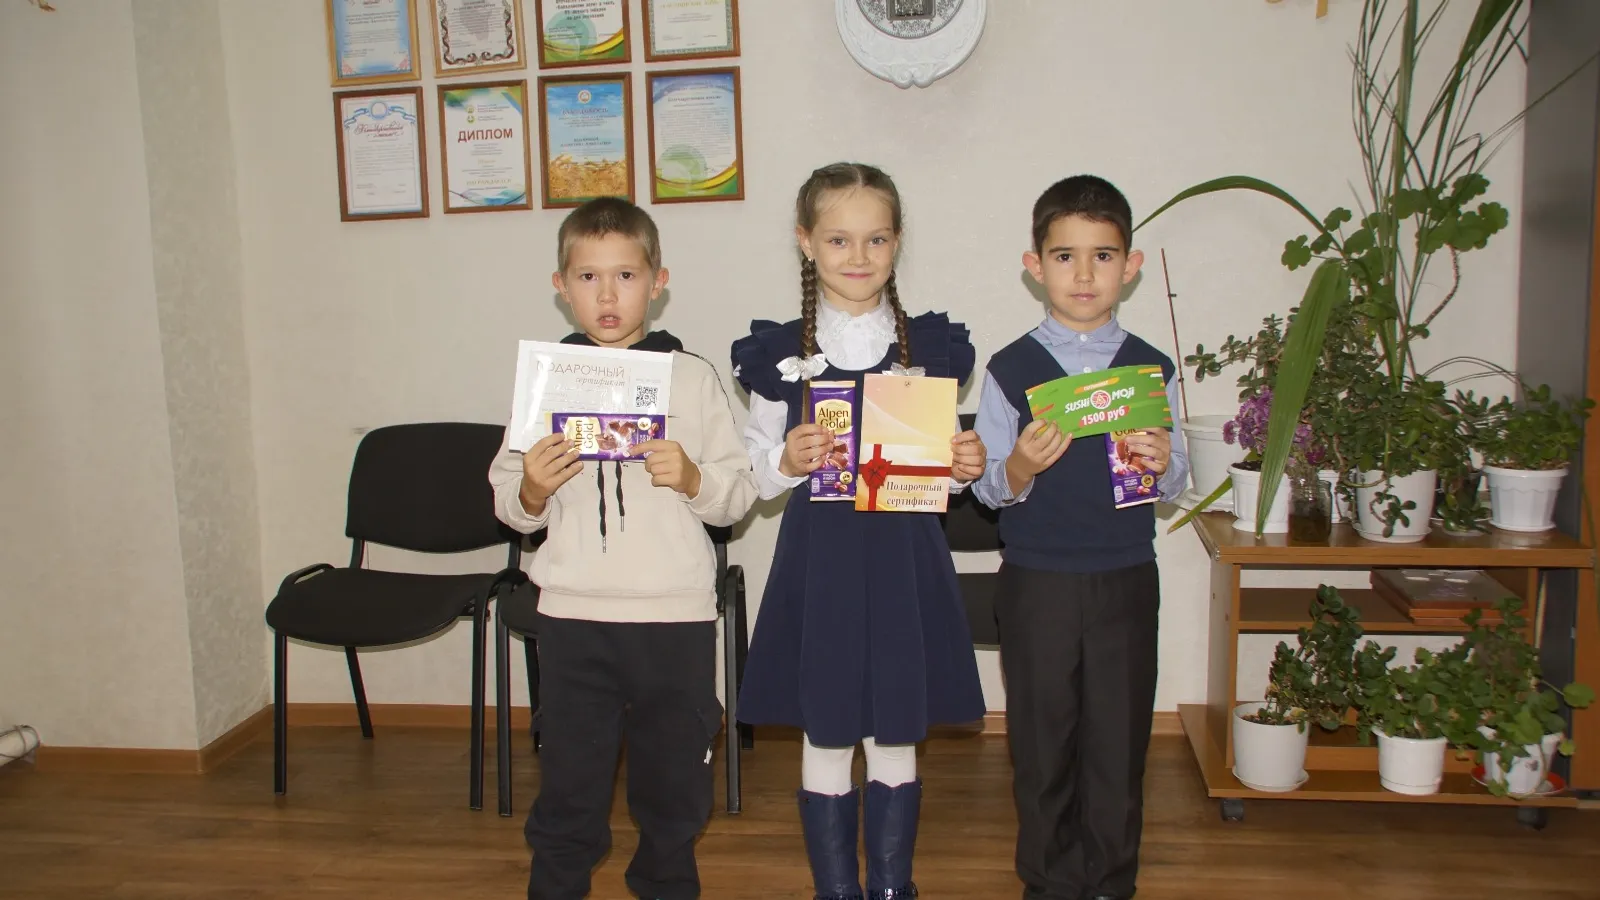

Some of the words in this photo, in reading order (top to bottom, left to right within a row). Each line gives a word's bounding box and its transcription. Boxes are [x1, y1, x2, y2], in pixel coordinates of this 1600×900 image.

[458, 128, 513, 143] ДИПЛОМ
[536, 360, 625, 378] ПОДАРОЧНЫЙ
[575, 376, 626, 388] сертификат
[817, 407, 849, 421] Alpen
[1081, 411, 1106, 426] 1500
[1106, 405, 1125, 422] руб
[820, 418, 846, 429] Gold
[574, 420, 585, 451] Alpen
[583, 423, 594, 449] Gold
[886, 481, 942, 493] Подарочный
[886, 496, 938, 507] сертификат
